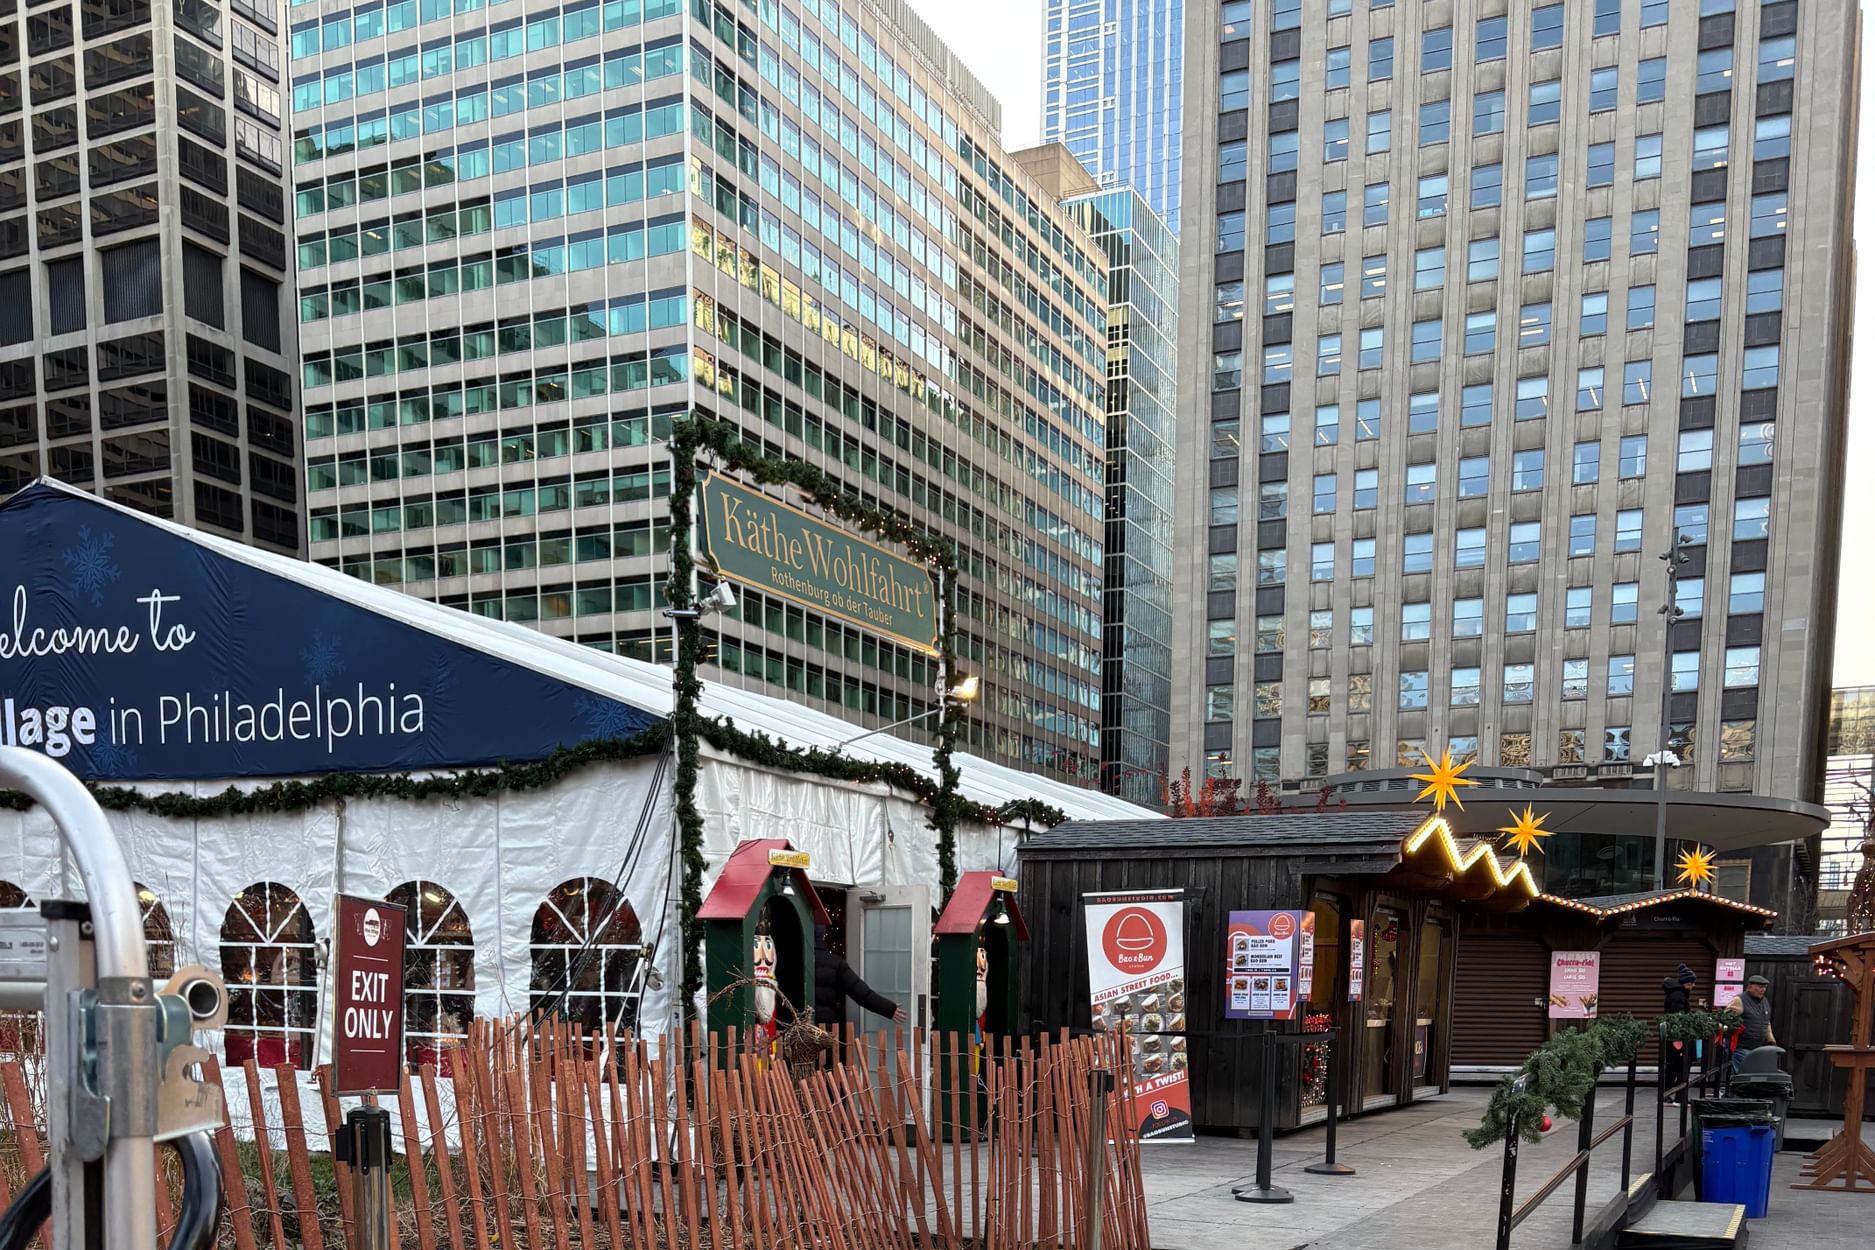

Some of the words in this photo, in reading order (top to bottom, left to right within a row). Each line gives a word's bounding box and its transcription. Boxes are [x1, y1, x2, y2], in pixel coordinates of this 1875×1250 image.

[720, 491, 804, 570] Käthe
[771, 566, 831, 608] Rothenburg
[832, 592, 844, 608] ob
[846, 594, 862, 614] der
[863, 602, 894, 626] Tauber
[136, 588, 196, 651] to
[0, 698, 96, 757] lage
[110, 697, 143, 745] in
[160, 682, 424, 753] Philadelphia
[352, 970, 389, 1003] EXIT
[1094, 988, 1119, 1002] ASIAN
[1120, 980, 1148, 994] STREET
[344, 1007, 394, 1040] ONLY
[1146, 1081, 1154, 1092] A
[1154, 1070, 1185, 1087] TWIST!
